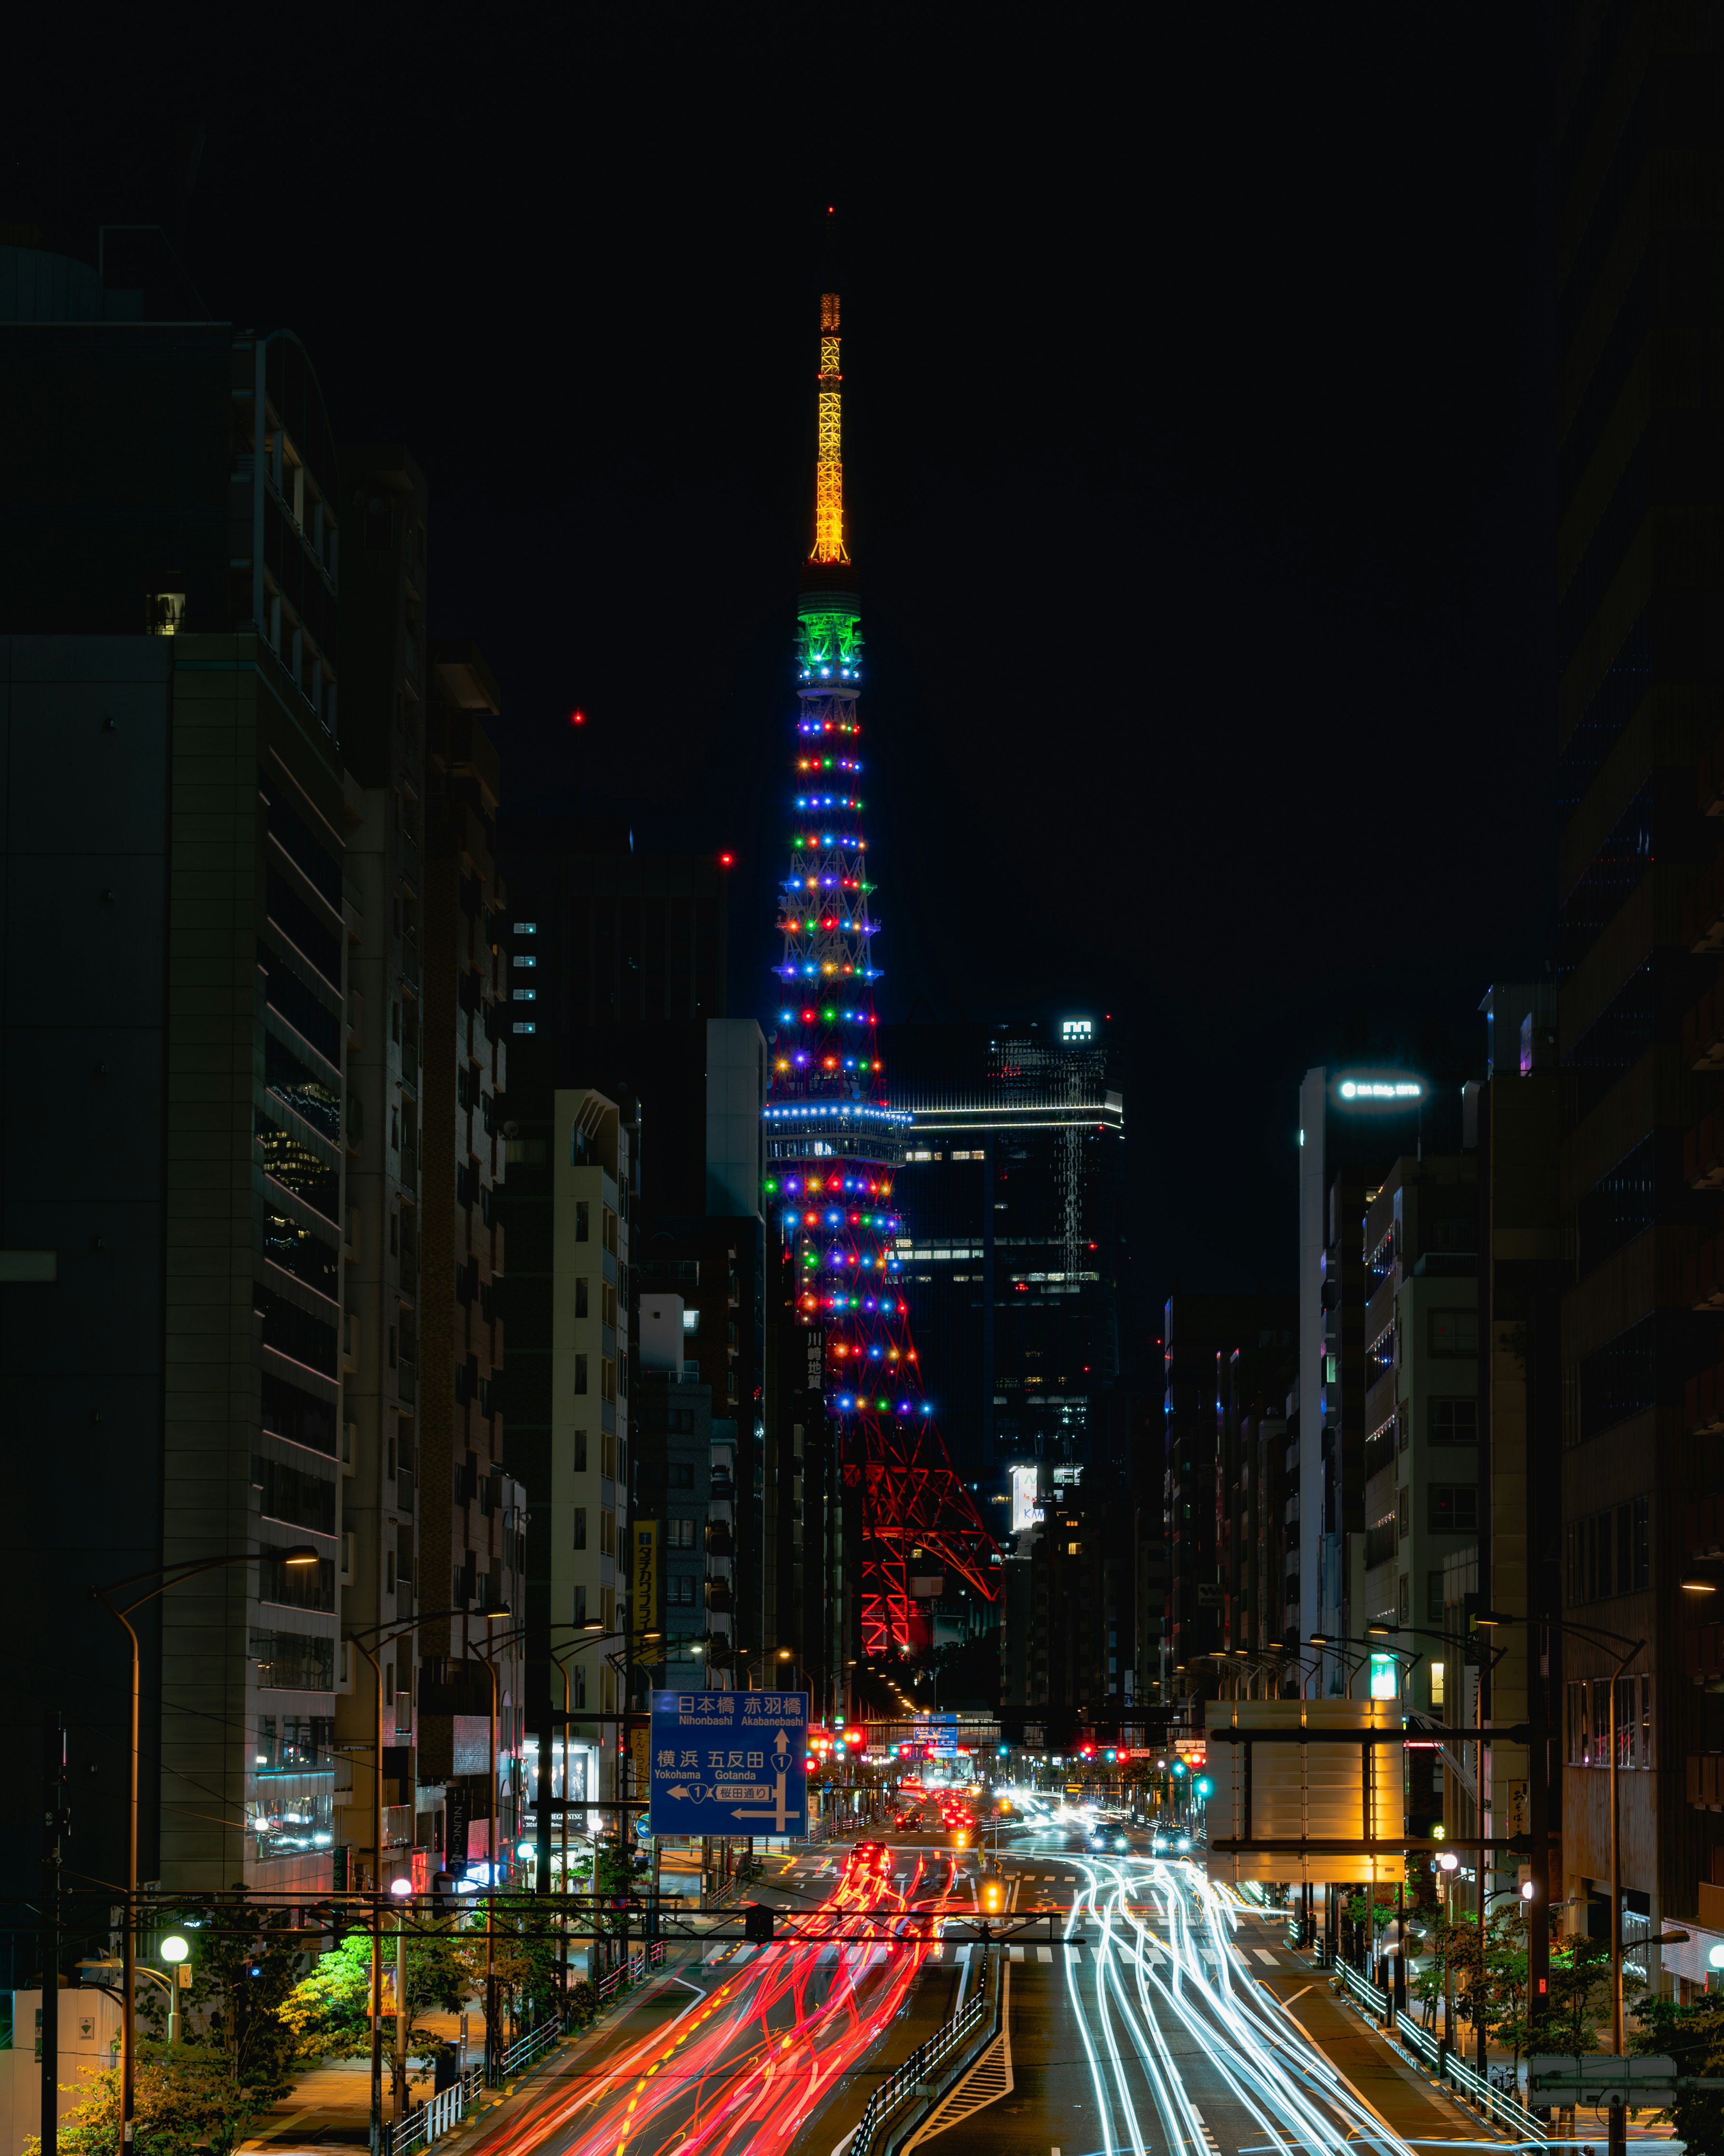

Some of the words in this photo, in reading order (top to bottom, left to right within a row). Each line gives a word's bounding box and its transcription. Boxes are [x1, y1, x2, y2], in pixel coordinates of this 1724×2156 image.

[807, 1332, 822, 1389] 川崎地質
[639, 1547, 651, 1654] タチカワブライド
[679, 1696, 735, 1714] 日本橋
[744, 1697, 801, 1715] 赤羽橋
[679, 1716, 733, 1725] Nihonbashi
[741, 1717, 804, 1727] Akabanebashi
[657, 1750, 699, 1768] 横浜
[708, 1751, 763, 1768] 五反田
[778, 1756, 784, 1768] 1
[655, 1770, 701, 1779] Yokohama
[715, 1770, 756, 1780] Gotanda
[694, 1786, 700, 1797] 1
[720, 1787, 766, 1799] 桜田通り
[453, 1806, 463, 1842] NUNC
